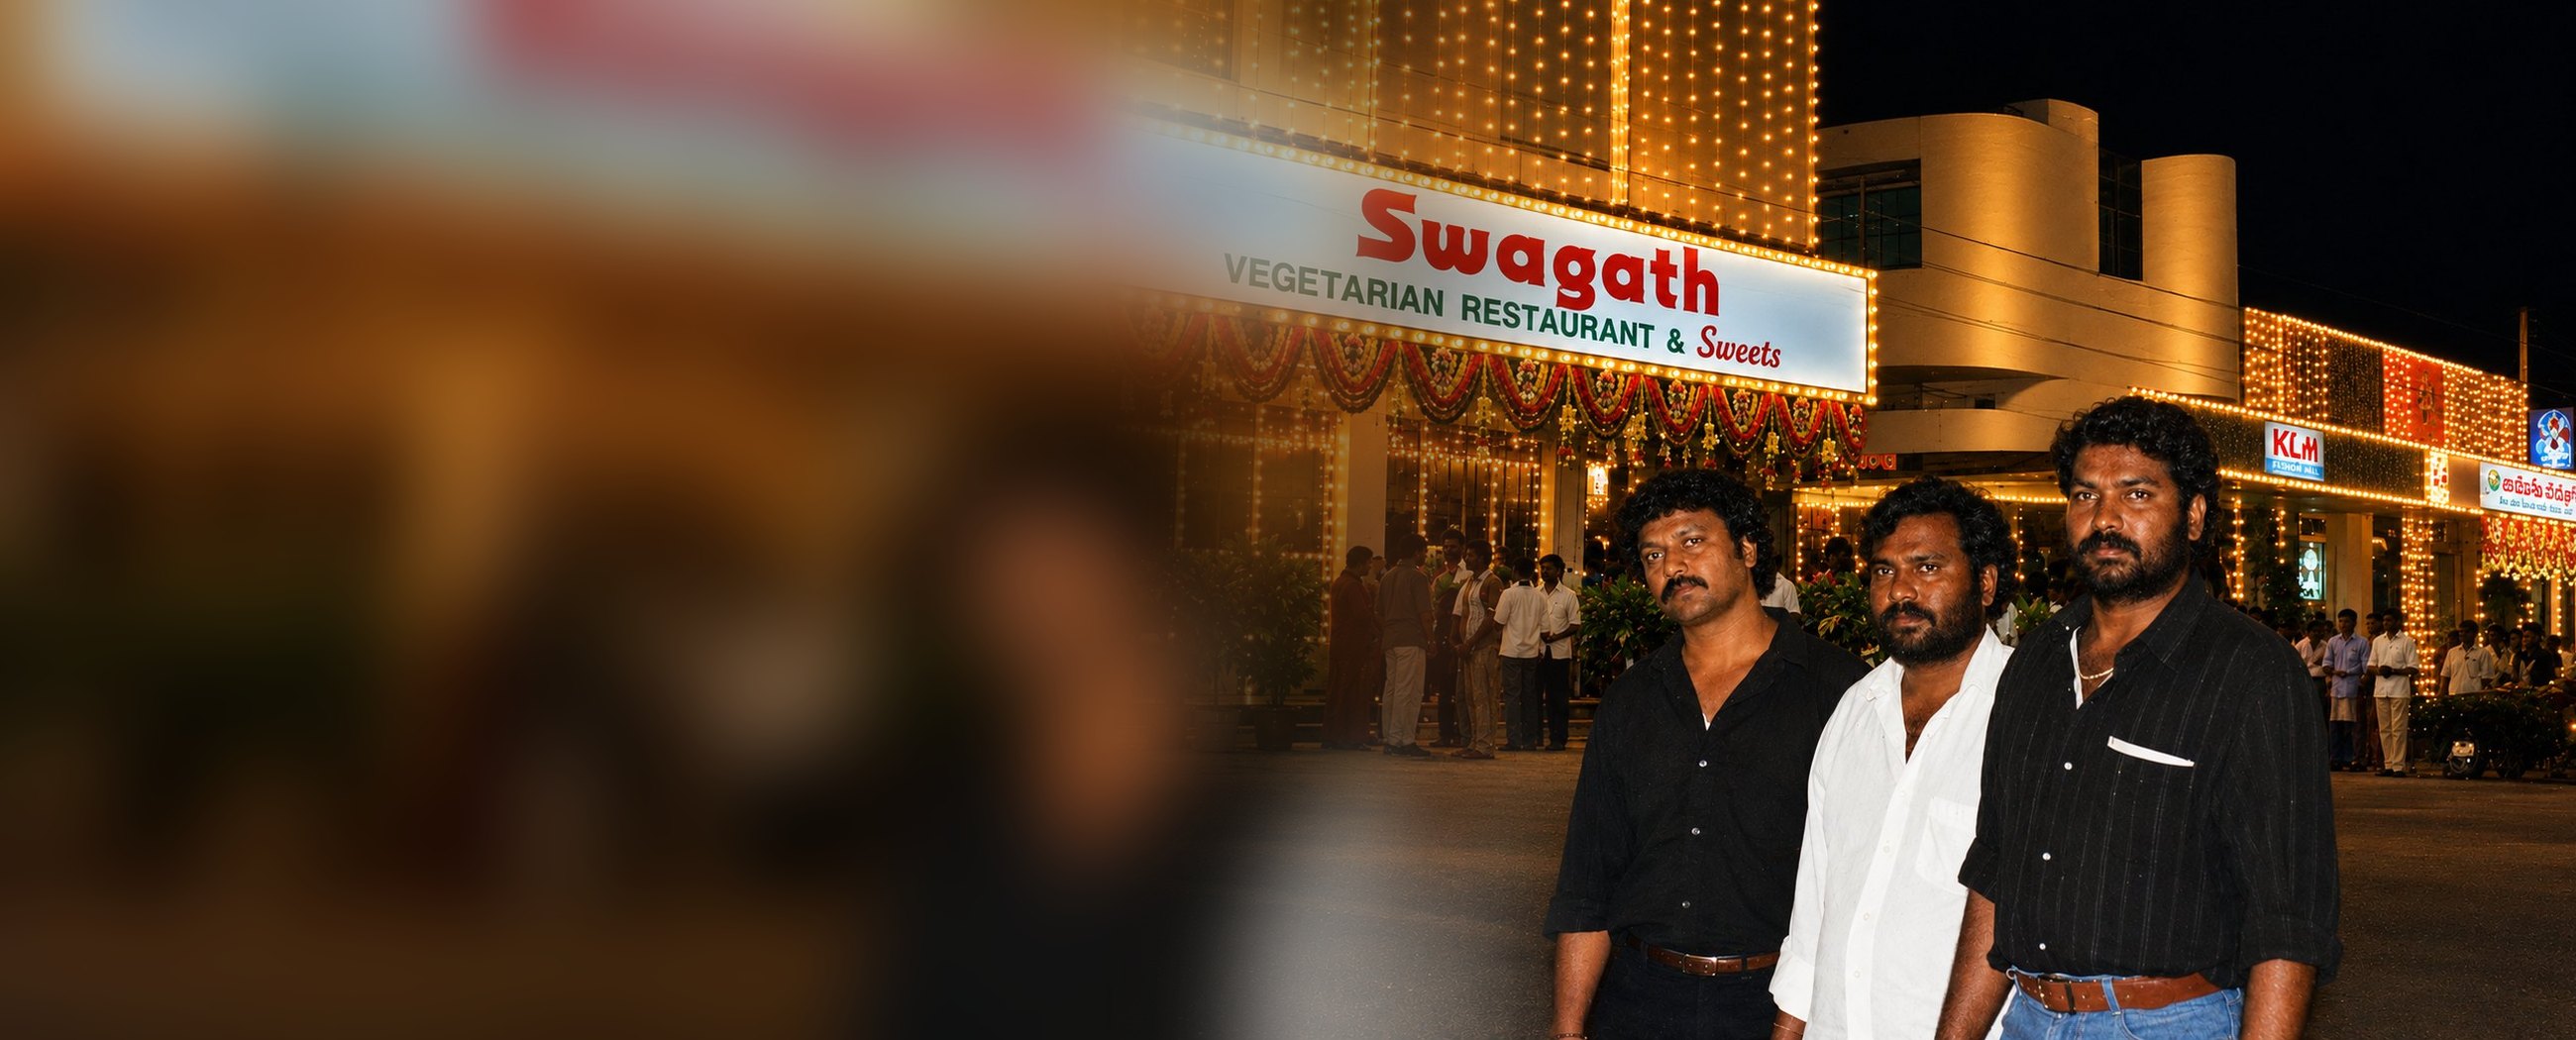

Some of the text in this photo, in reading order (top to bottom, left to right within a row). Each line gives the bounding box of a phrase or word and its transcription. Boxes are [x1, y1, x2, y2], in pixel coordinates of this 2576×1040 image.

[1356, 188, 1720, 316] Swagath
[1224, 253, 1781, 368] VEGETARIAN RESTAURANT & Sweets
[2273, 428, 2318, 463] KLM
